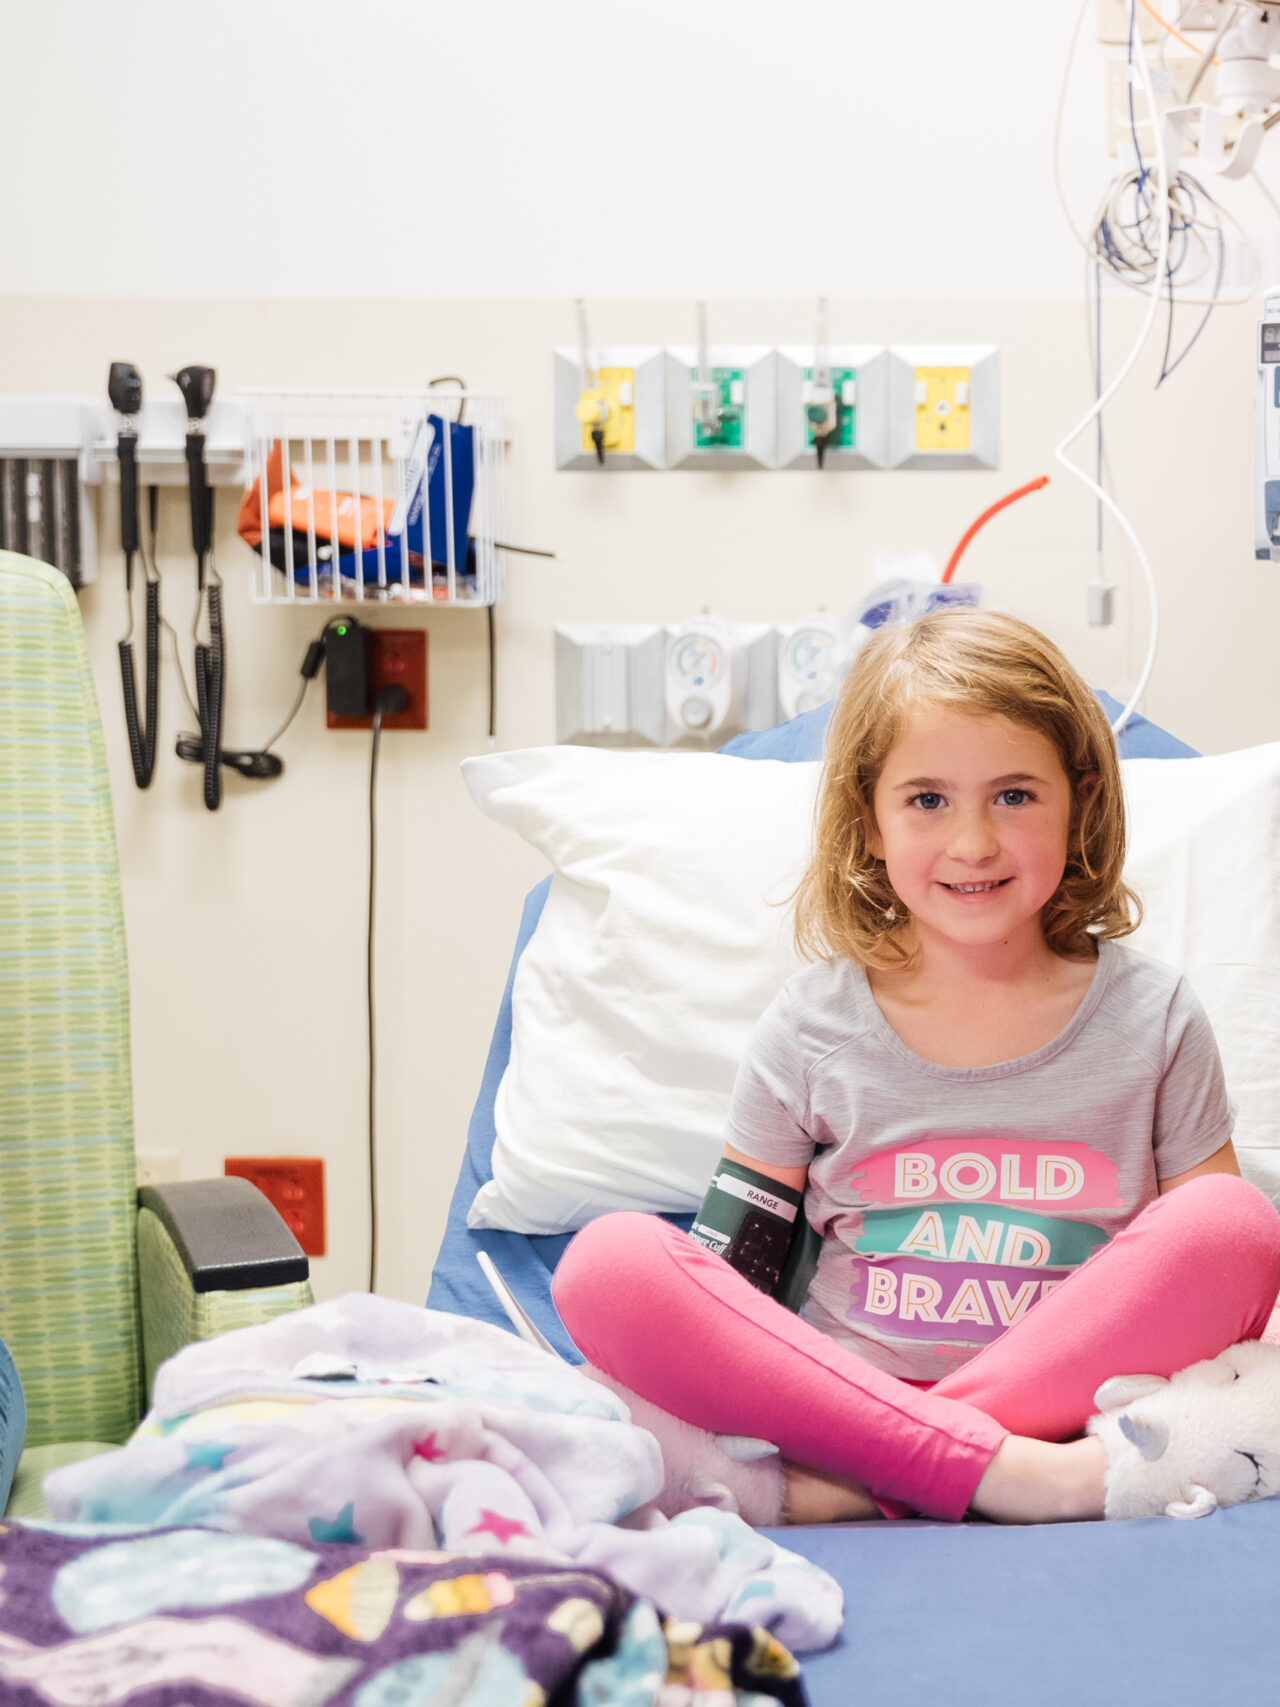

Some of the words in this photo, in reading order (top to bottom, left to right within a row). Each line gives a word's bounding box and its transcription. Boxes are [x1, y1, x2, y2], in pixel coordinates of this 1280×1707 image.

[746, 1189, 779, 1210] RANGE
[894, 1152, 1085, 1200] BOLD
[709, 1240, 728, 1255] Cuff
[897, 1211, 1051, 1266] AND
[864, 1265, 1067, 1327] BRAV
